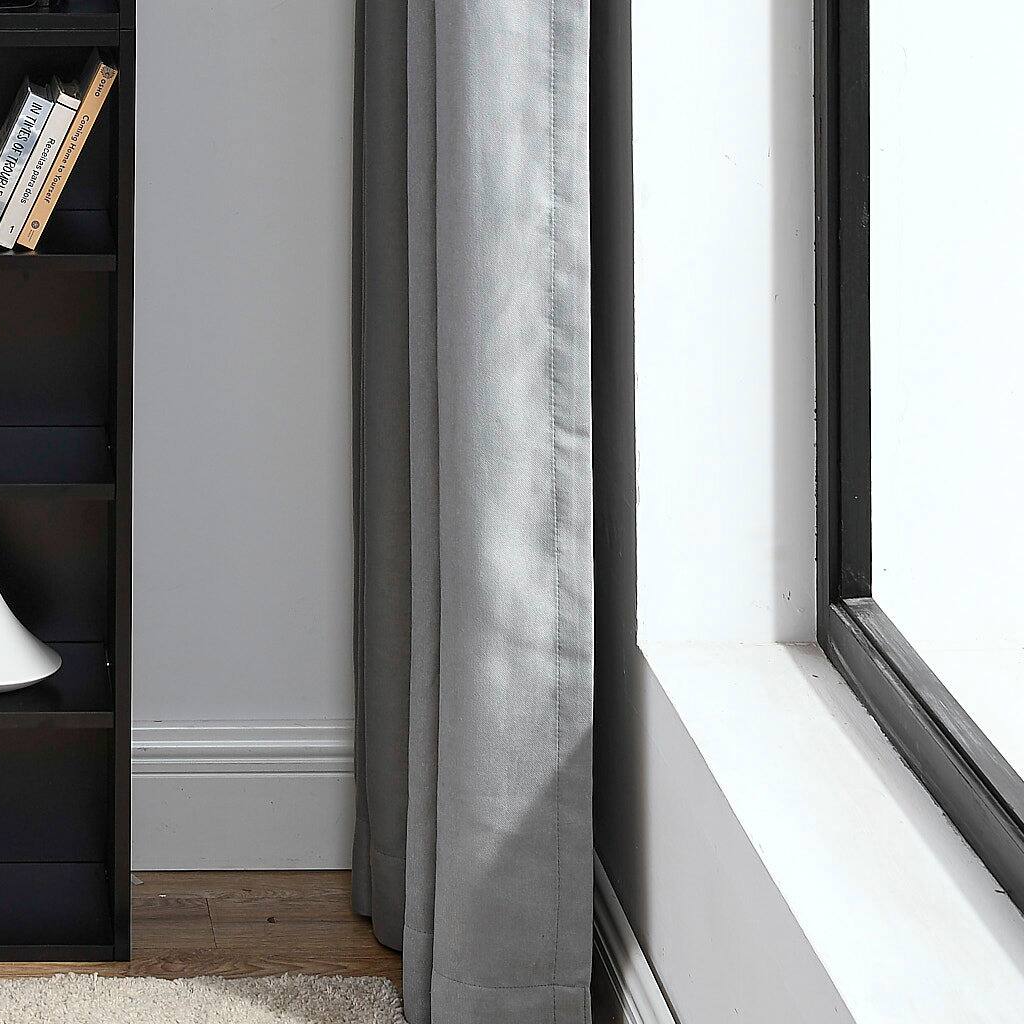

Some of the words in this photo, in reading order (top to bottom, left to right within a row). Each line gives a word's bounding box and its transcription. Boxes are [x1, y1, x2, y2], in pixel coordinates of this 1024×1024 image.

[94, 79, 106, 97] OSHO
[30, 102, 43, 115] IN
[16, 115, 37, 142] TIMES
[70, 115, 90, 142] Coming
[11, 142, 25, 156] OF
[35, 137, 56, 170] Receitas
[63, 142, 77, 164] Home
[27, 169, 39, 188] para
[57, 165, 66, 173] to
[20, 188, 32, 204] dois
[44, 175, 62, 204] Yourself
